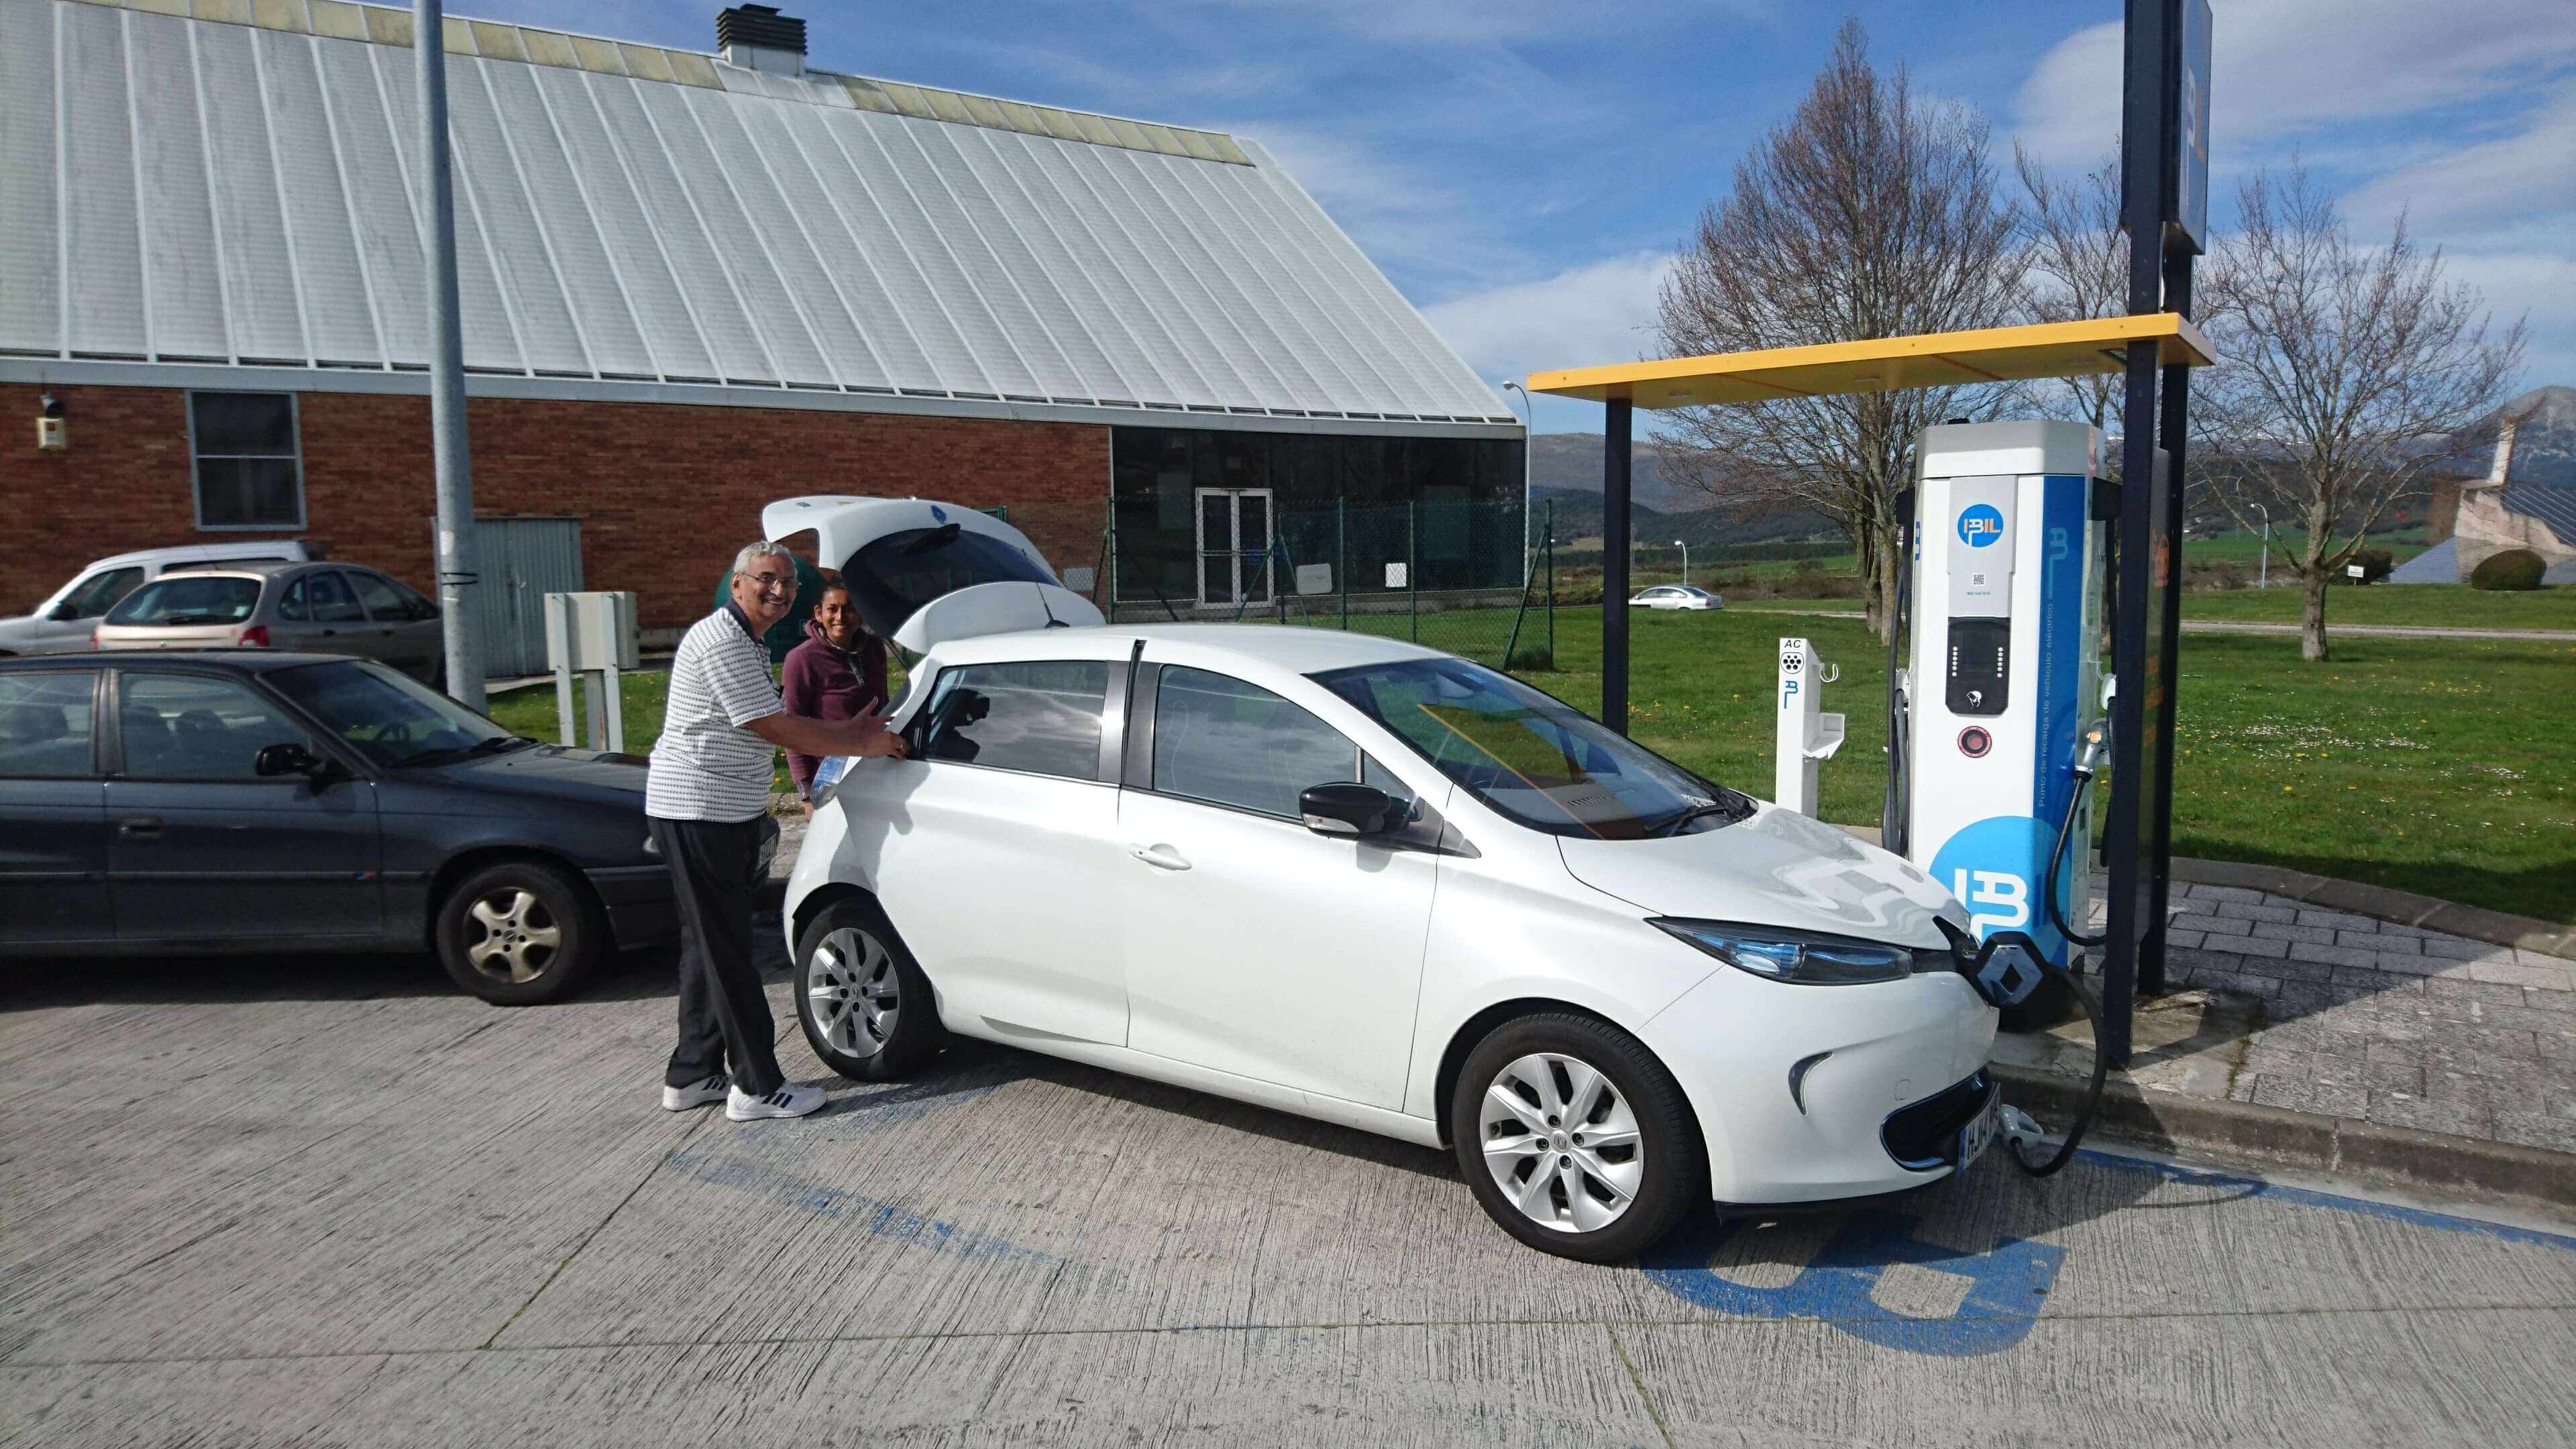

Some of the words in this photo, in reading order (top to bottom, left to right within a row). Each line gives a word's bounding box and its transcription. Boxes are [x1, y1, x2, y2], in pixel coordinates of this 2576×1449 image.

[1964, 519, 2000, 546] IBIL
[1784, 639, 1801, 648] AC
[2043, 700, 2050, 713] de
[2041, 716, 2050, 757] recarga
